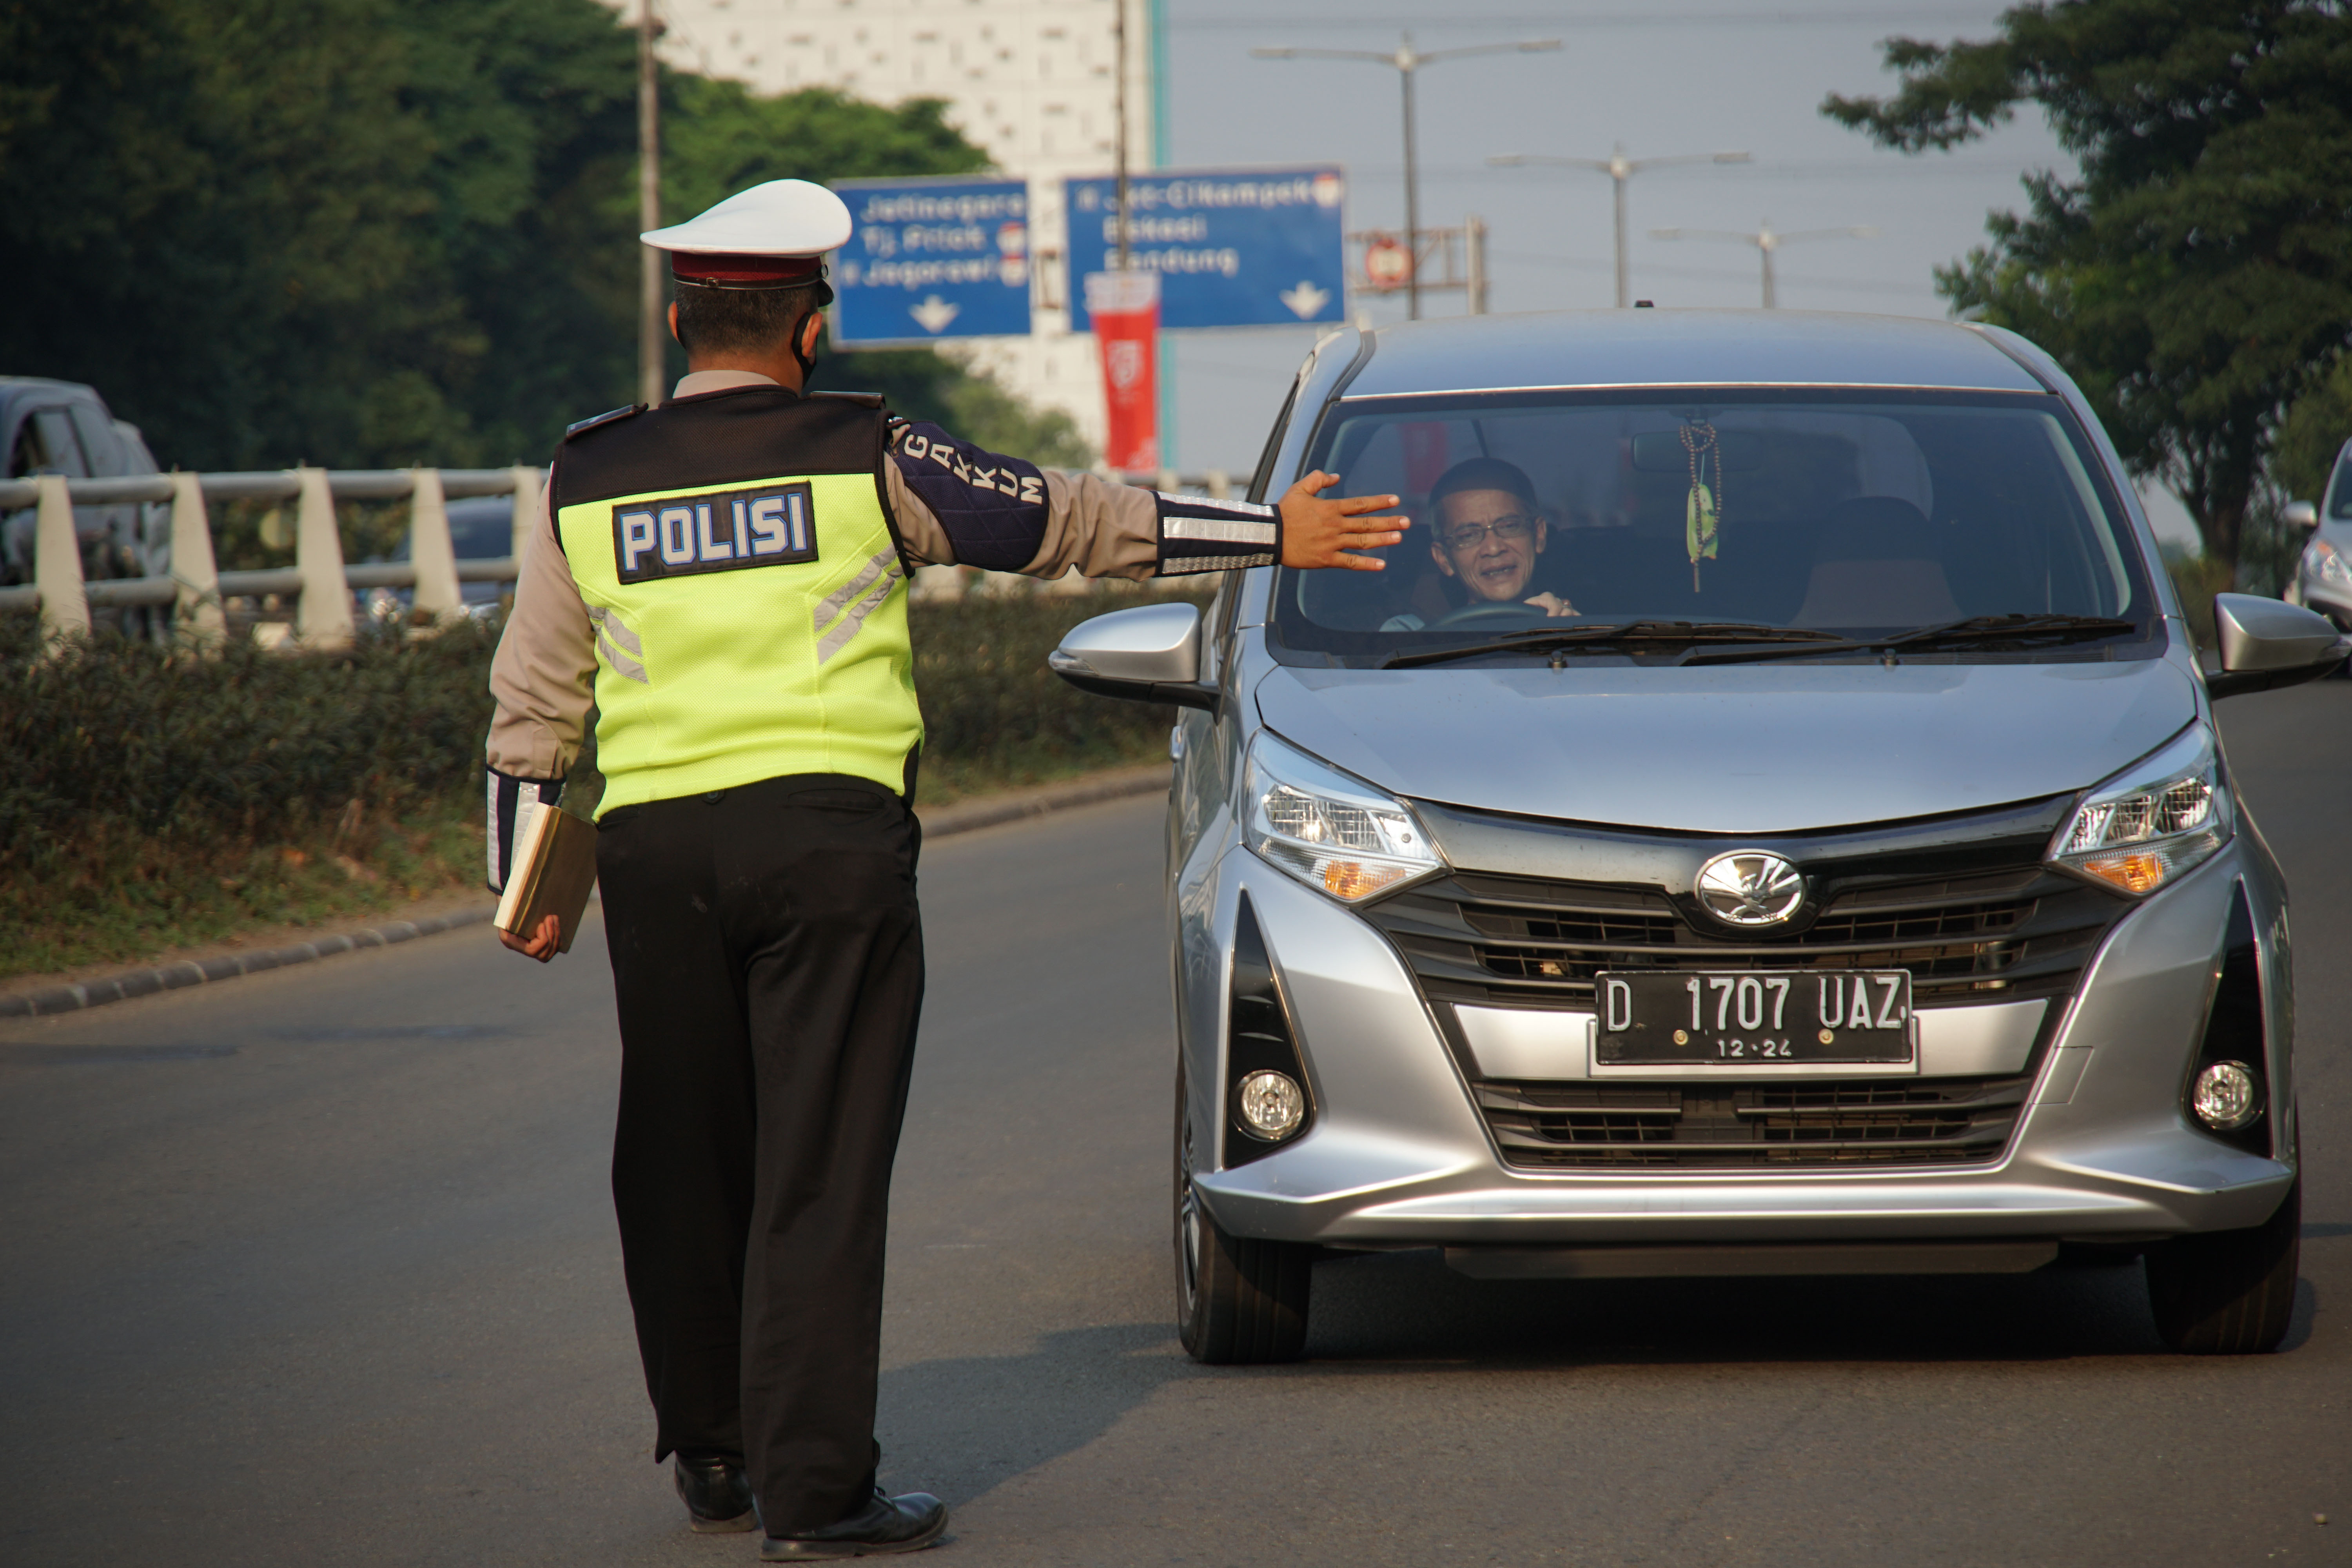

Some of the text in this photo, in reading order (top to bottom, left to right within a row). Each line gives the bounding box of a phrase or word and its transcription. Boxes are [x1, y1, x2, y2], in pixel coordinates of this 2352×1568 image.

[904, 434, 1043, 505] GAKKUM
[619, 492, 809, 571] POLISI
[1607, 976, 1902, 1031] D 1707 UAZ
